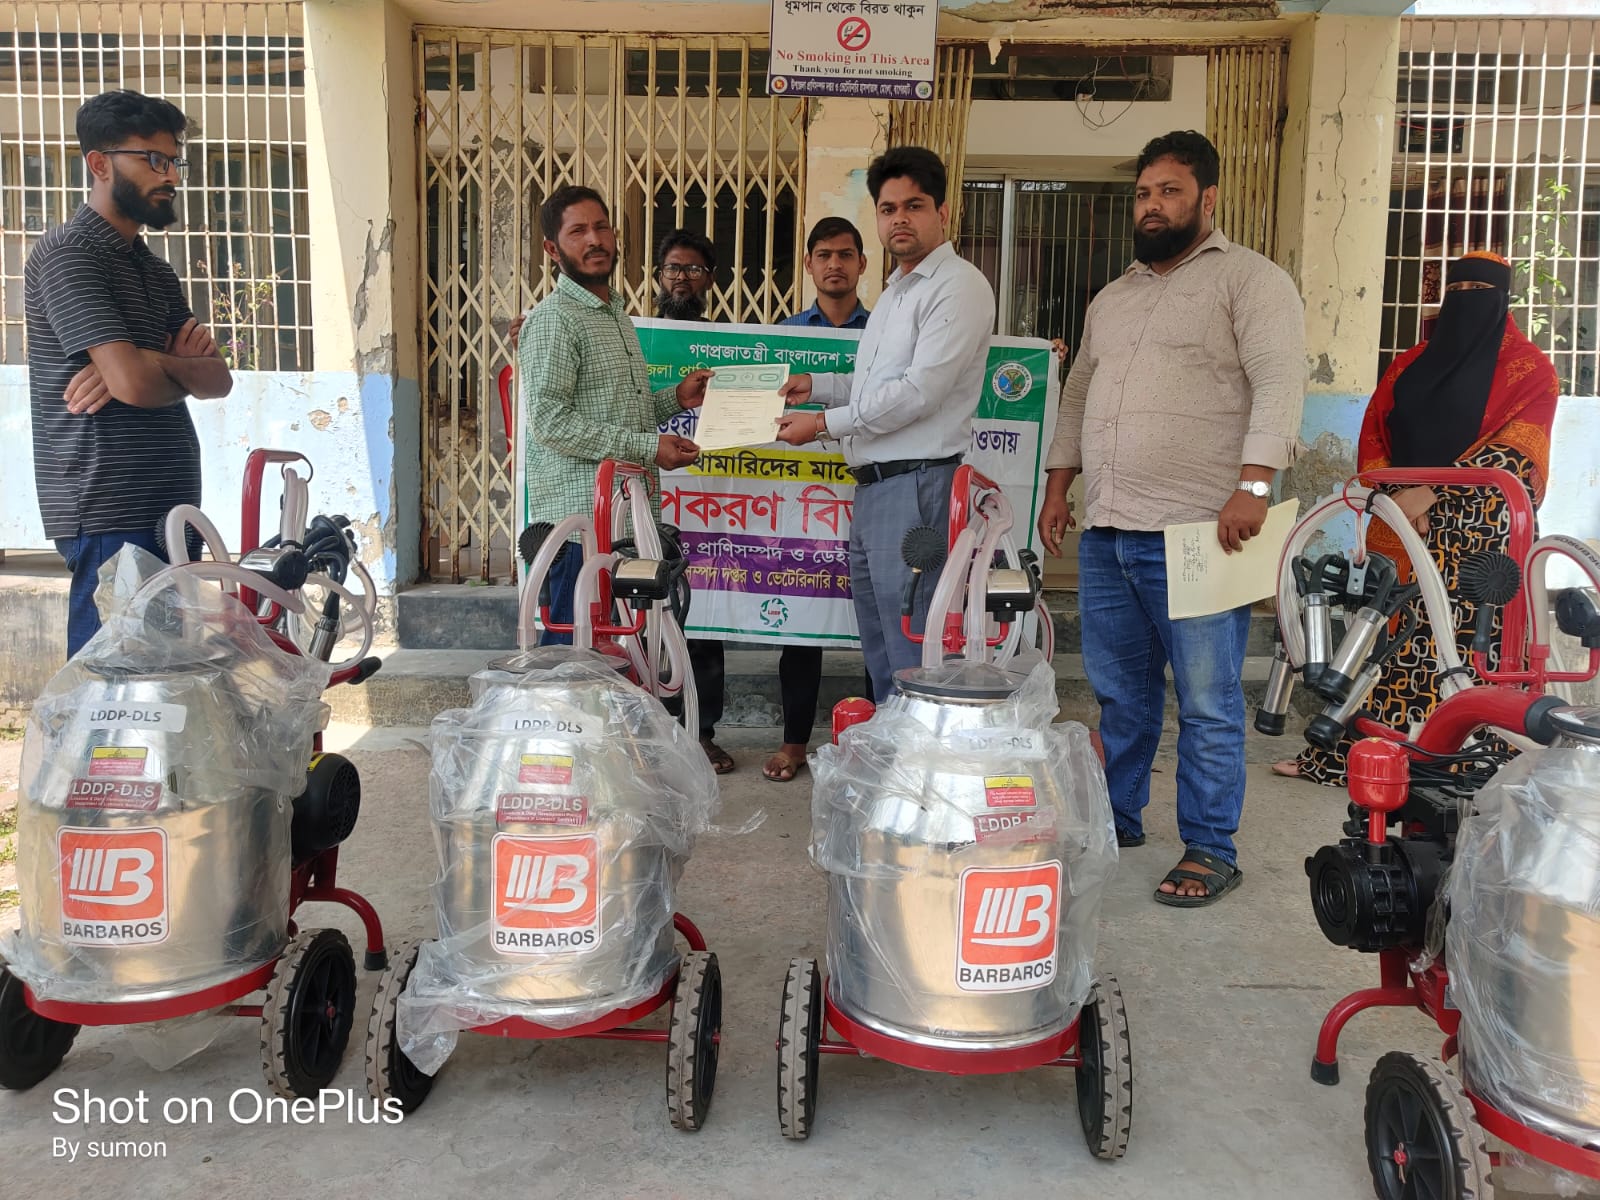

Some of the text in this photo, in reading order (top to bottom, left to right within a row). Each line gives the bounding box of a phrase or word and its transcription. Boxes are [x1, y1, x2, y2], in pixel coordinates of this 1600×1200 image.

[785, 0, 925, 19] ধূমপান থেকে বিরত থাকুন
[777, 50, 930, 65] No Smoking in This Area
[793, 65, 821, 73] Thank
[824, 67, 840, 75] you
[875, 68, 913, 78] smoking
[689, 342, 769, 363] গণপ্রজাতন্ত্রী
[774, 349, 839, 367] বাংলাদেশ
[661, 486, 785, 532] পকরণ
[696, 537, 784, 561] প্রাণিসম্পদ
[791, 549, 805, 562] ও
[721, 567, 748, 584] দপ্তর
[752, 571, 762, 584] ও
[766, 568, 832, 589] ভেটেরিনারি
[90, 710, 162, 722] LDDP-DLS
[71, 782, 155, 798] LDDP-DLS
[502, 796, 583, 812] LDDP-DLS
[63, 921, 163, 939] BARBAROS
[496, 929, 595, 947] BARBAROS
[959, 959, 1052, 983] BARBAROS
